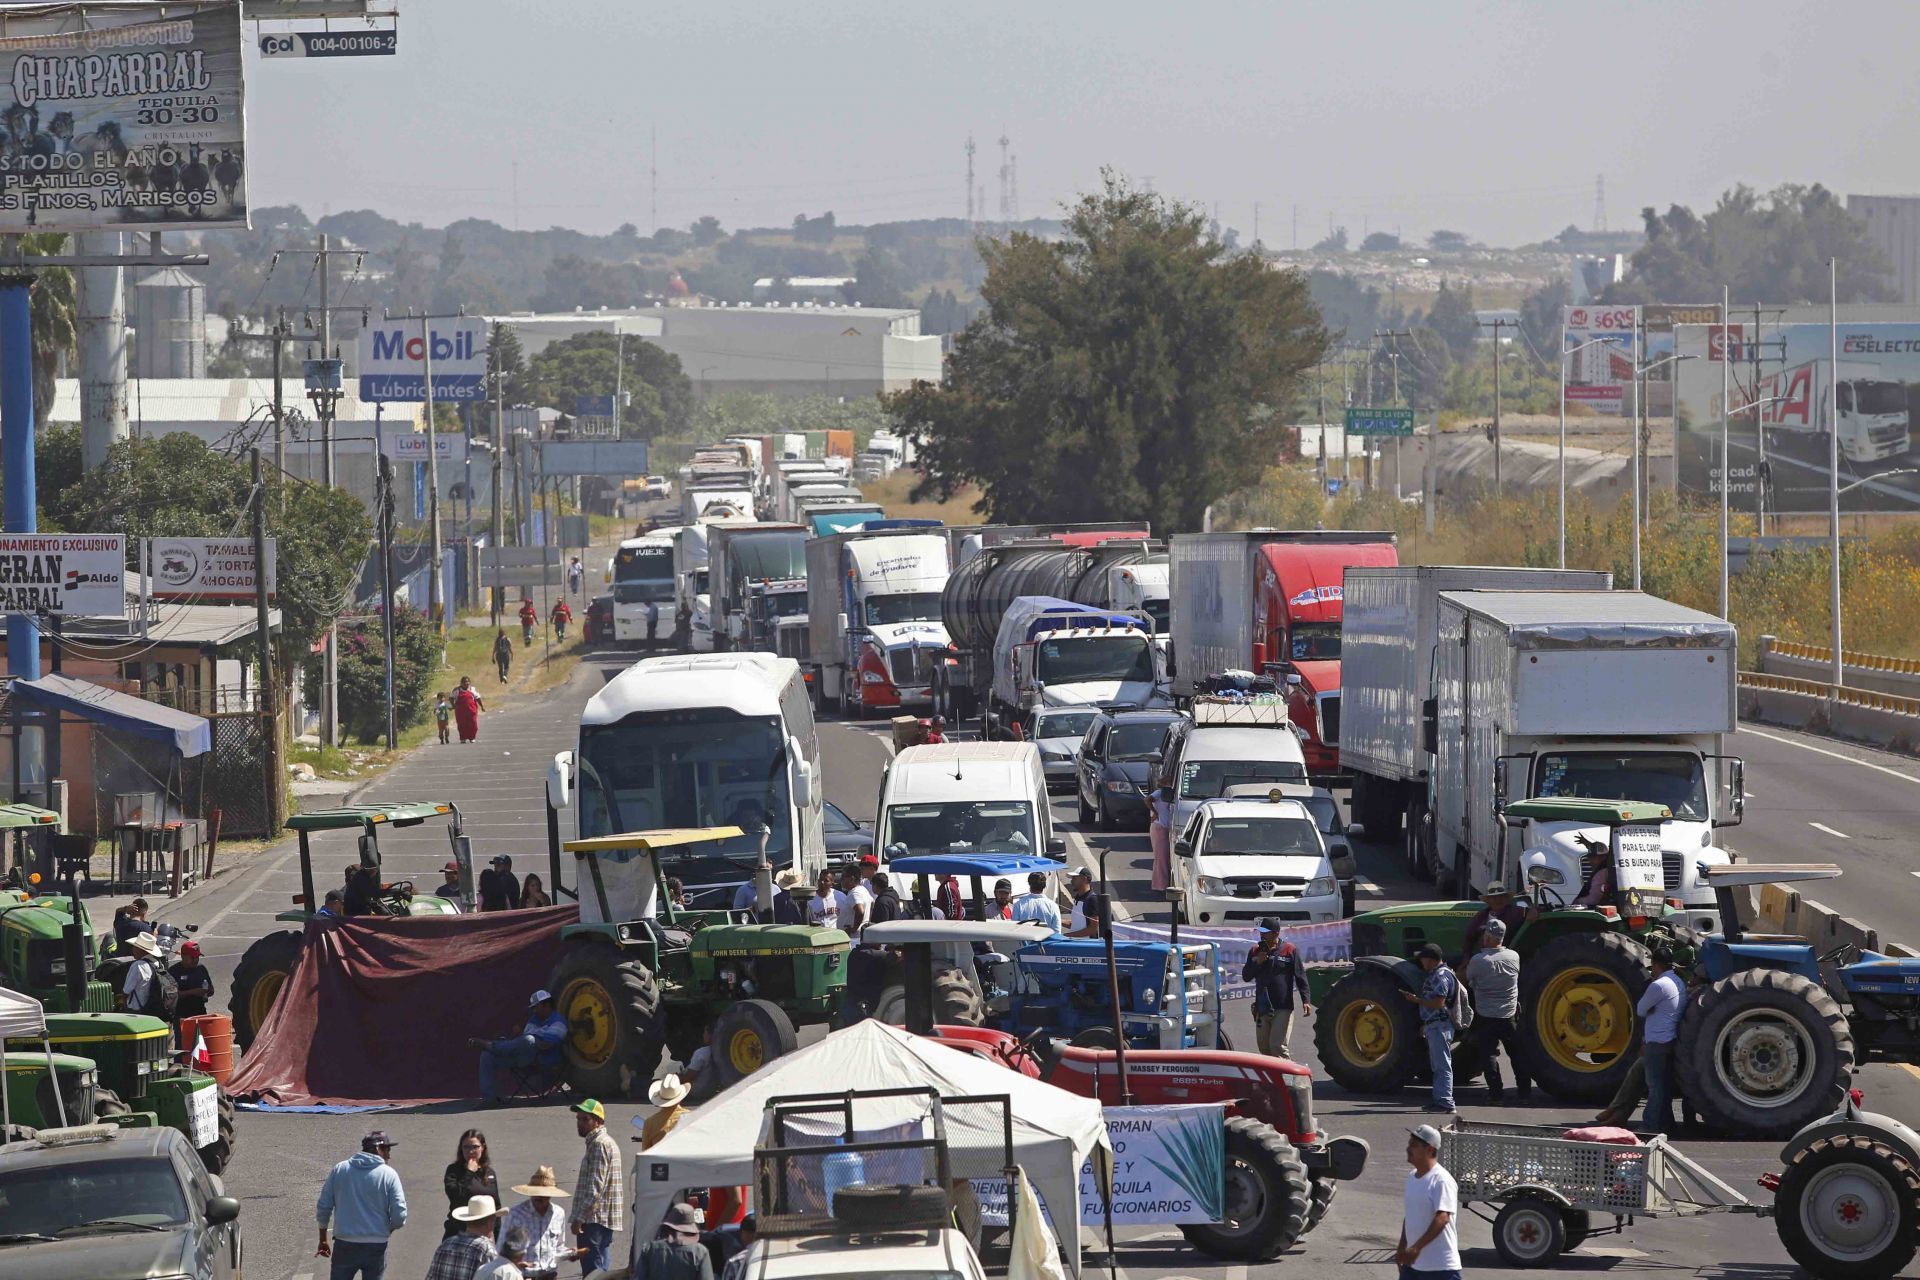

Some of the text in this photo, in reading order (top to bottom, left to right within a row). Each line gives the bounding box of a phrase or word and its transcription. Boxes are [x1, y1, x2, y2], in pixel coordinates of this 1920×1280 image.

[310, 36, 395, 51] 004-00106-2
[11, 50, 211, 107] CHAPARRAL
[138, 96, 219, 108] TEQUILA
[137, 107, 218, 124] 30-30
[19, 152, 84, 170] TODO
[94, 151, 116, 168] EL
[124, 145, 177, 168] AÑO
[5, 171, 125, 188] PLATILLOS,
[22, 191, 97, 211] FINOS,
[103, 188, 217, 207] MARISCOS
[373, 330, 472, 360] Mobil
[62, 539, 118, 551] EXCLUSIVO
[205, 545, 257, 556] TAMALE
[0, 555, 63, 584] GRAN
[216, 560, 257, 572] TORTA
[90, 573, 119, 583] Aldo
[1622, 843, 1639, 852] PARA
[1619, 858, 1630, 868] ES
[1631, 858, 1650, 868] BUENO
[713, 949, 728, 957] JOHN
[1055, 956, 1079, 964] FORD
[1130, 1064, 1200, 1074] MASSEY FERGUSON
[1199, 1077, 1224, 1086] Turbo
[1125, 1161, 1135, 1174] Y
